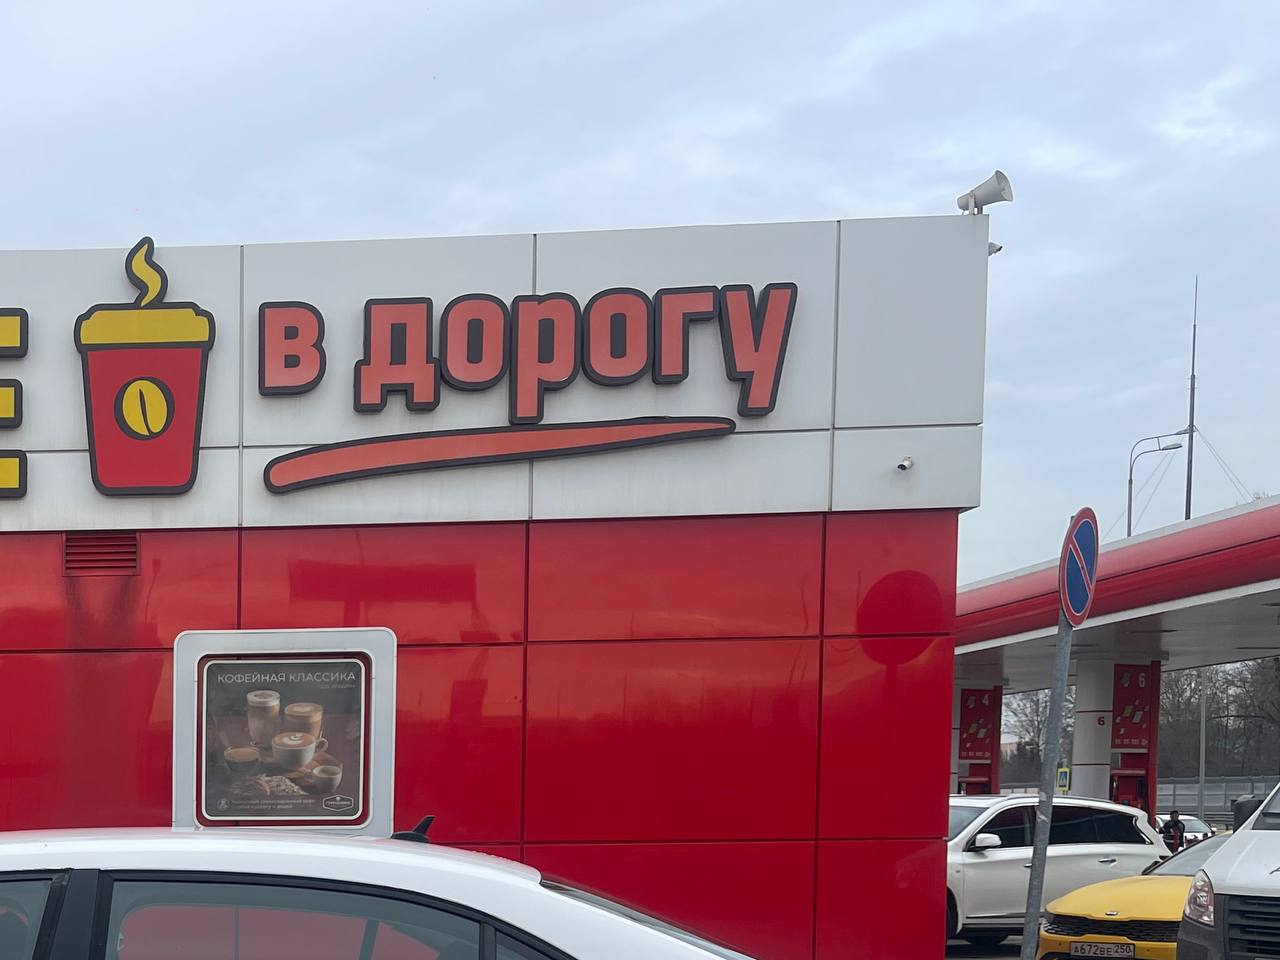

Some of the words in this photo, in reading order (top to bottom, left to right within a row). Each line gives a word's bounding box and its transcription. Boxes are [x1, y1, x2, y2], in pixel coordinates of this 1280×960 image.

[217, 671, 286, 684] КОФЕЙНАЯ
[289, 671, 356, 682] КЛАССИКА
[1097, 716, 1105, 726] 6
